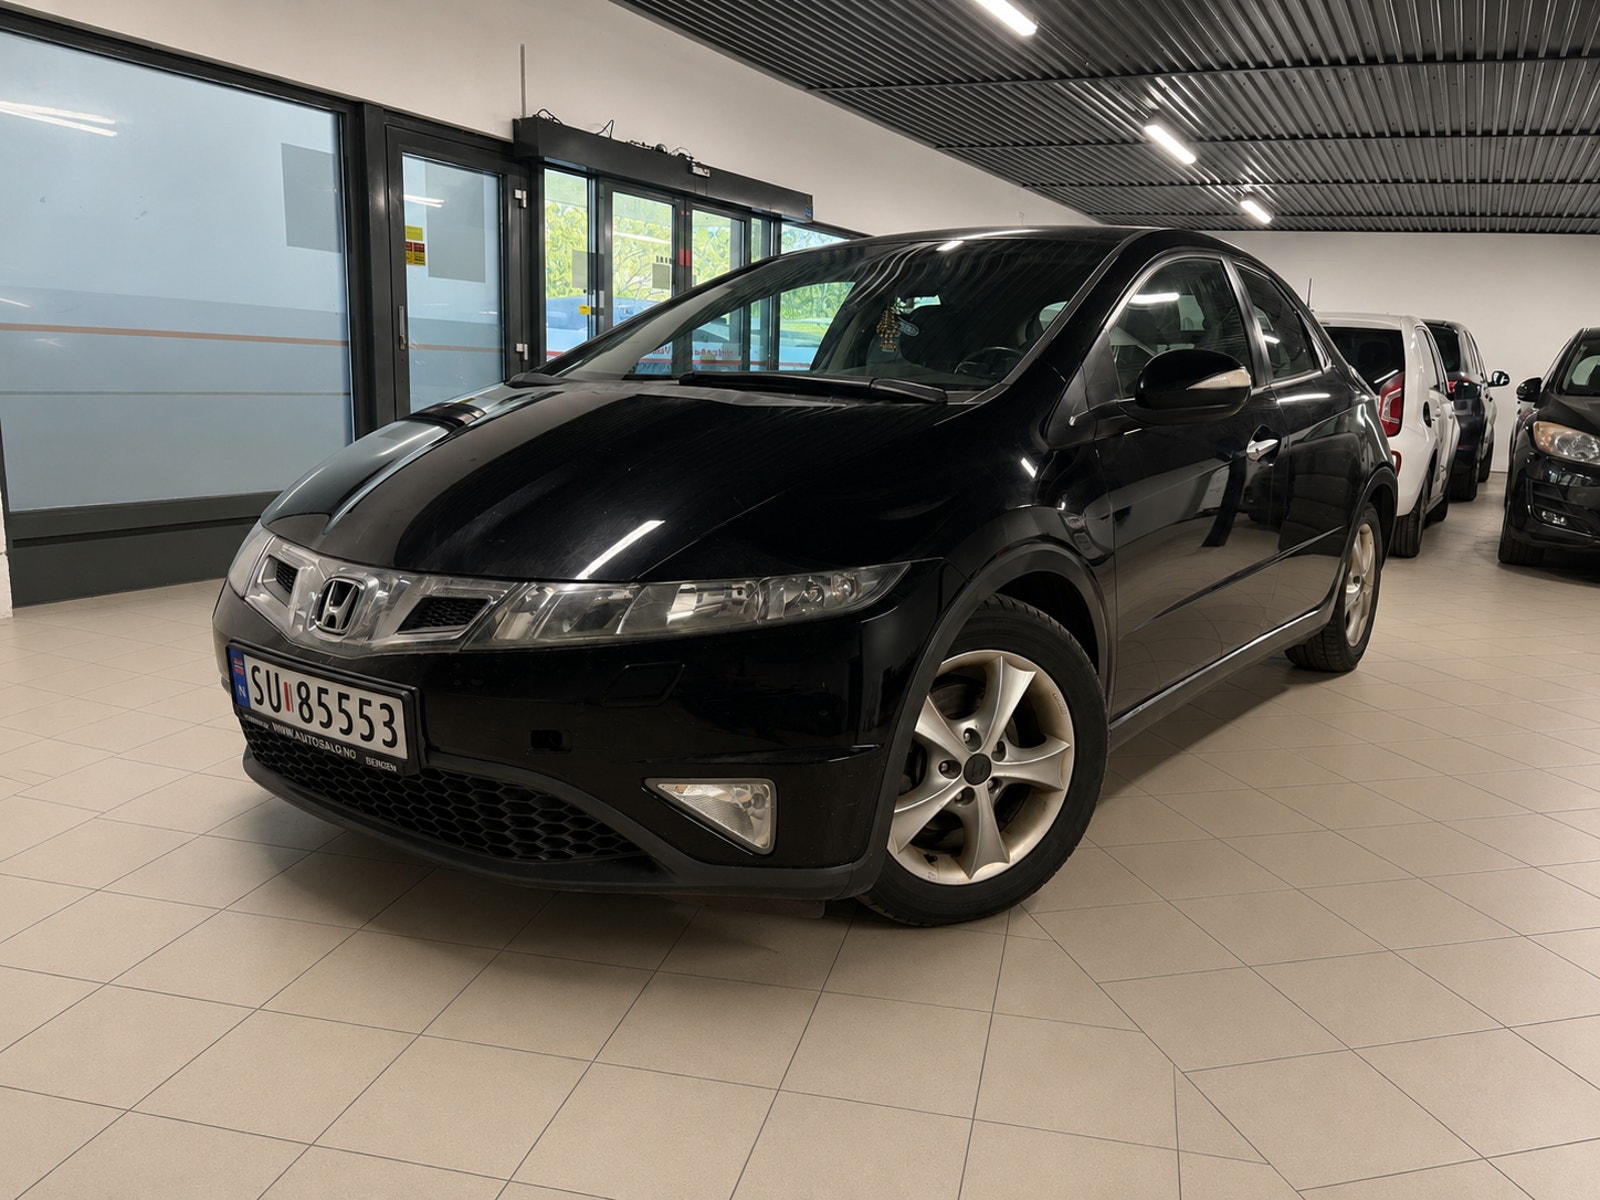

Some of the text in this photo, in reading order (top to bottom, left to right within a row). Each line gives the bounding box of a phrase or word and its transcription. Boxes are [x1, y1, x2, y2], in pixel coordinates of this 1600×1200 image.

[238, 684, 247, 698] N
[251, 665, 398, 749] SU 85553
